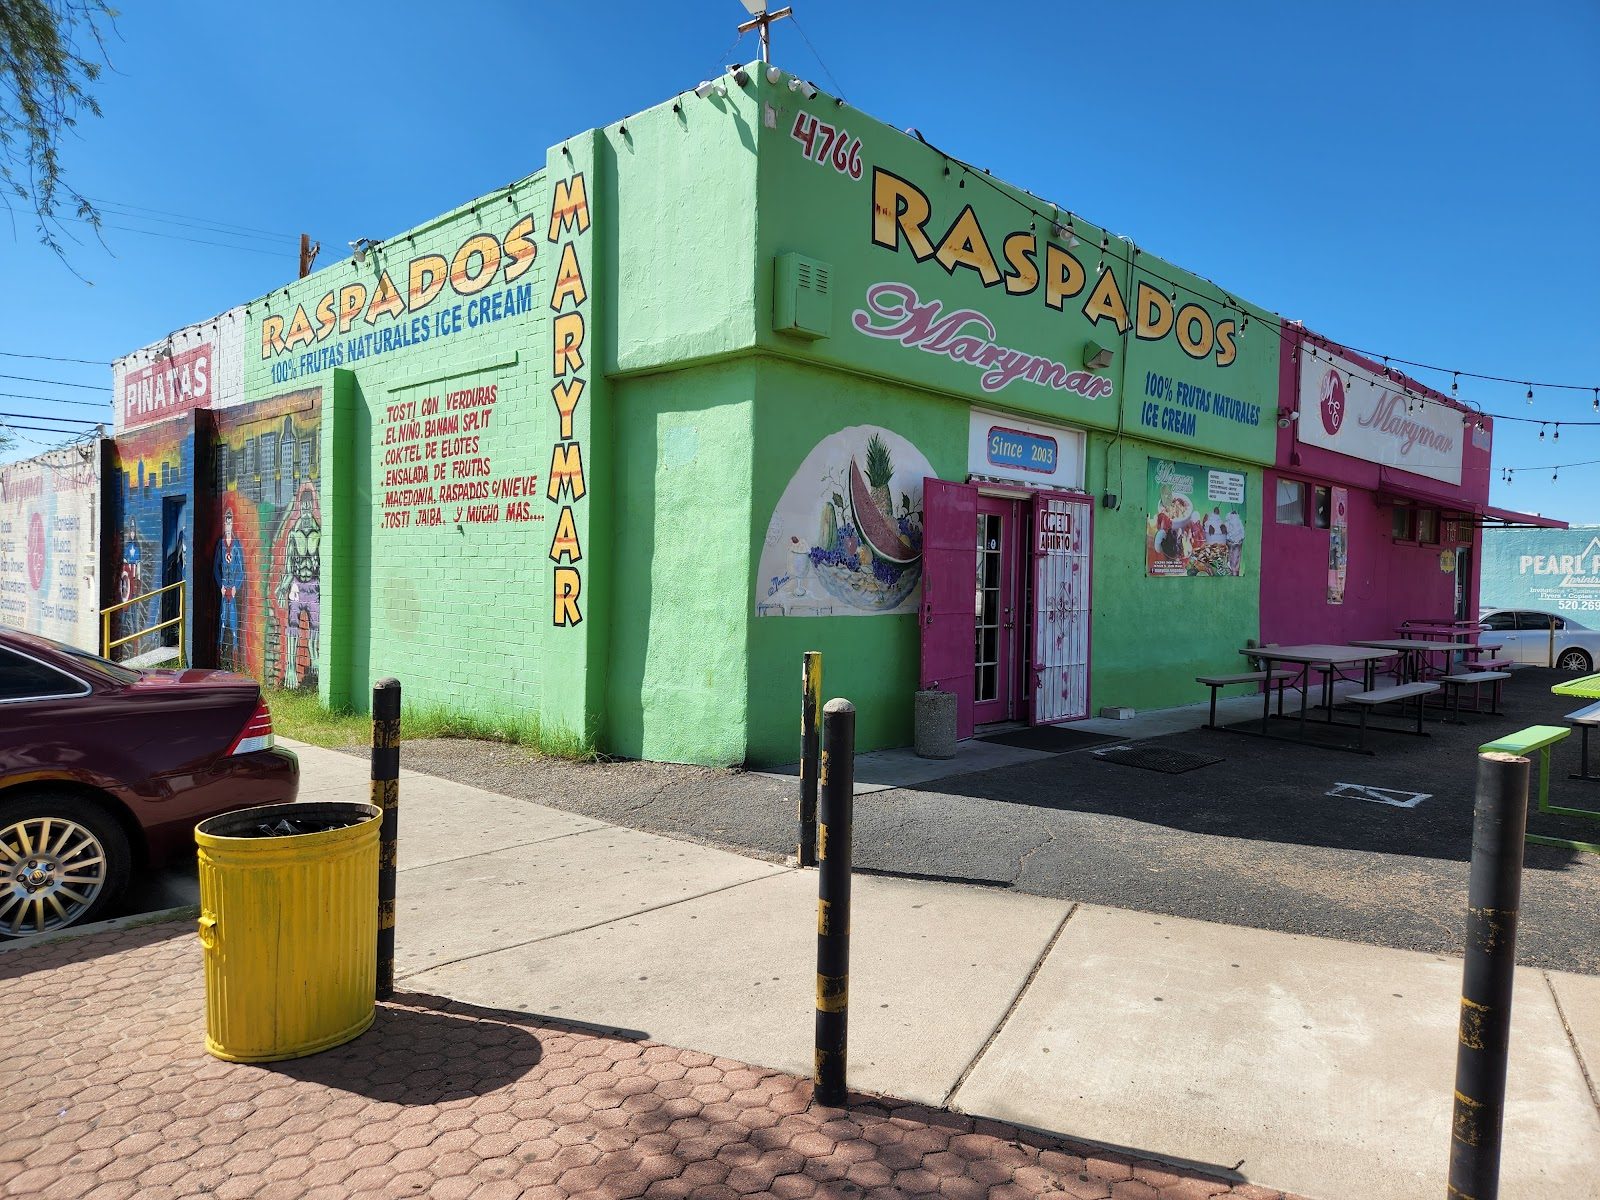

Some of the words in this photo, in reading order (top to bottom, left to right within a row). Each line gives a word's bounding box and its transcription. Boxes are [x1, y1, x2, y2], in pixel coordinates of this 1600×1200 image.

[790, 110, 863, 181] 4766
[262, 213, 538, 360] RASPADOS
[872, 165, 1236, 368] RASPADOS
[271, 357, 297, 384] 100%
[300, 342, 344, 377] FRUTAS
[347, 315, 430, 363] NATURALES
[435, 305, 462, 337] ICE
[467, 283, 532, 328] CREAM
[852, 282, 1113, 400] Marymar
[127, 356, 208, 418] PIÑATAS
[387, 401, 416, 423] TOSTI
[422, 396, 439, 416] CON
[446, 385, 497, 410] VERDURAS
[546, 172, 591, 627] MARYMAR
[1145, 371, 1172, 402] 100%
[1176, 381, 1211, 413] FRUTAS
[1212, 392, 1260, 427] NATURALES
[386, 427, 396, 445] EL
[425, 414, 458, 439] BANANA
[463, 409, 492, 432] SPLIT
[1141, 401, 1159, 428] ICE
[1161, 406, 1197, 437] CREAM
[1358, 390, 1453, 455] Marymar
[385, 444, 421, 465] COKTEL
[426, 441, 437, 459] DE
[442, 436, 479, 458] ELOTES
[386, 465, 428, 487] ENSALADA
[434, 462, 446, 481] DE
[452, 457, 490, 478] FRUTAS
[992, 436, 1023, 458] Since
[1032, 444, 1053, 464] 2003
[439, 480, 489, 503] RASPADOS
[385, 511, 410, 529] TOSTI
[467, 504, 499, 523] MUCHO
[1520, 554, 1586, 575] PEARL
